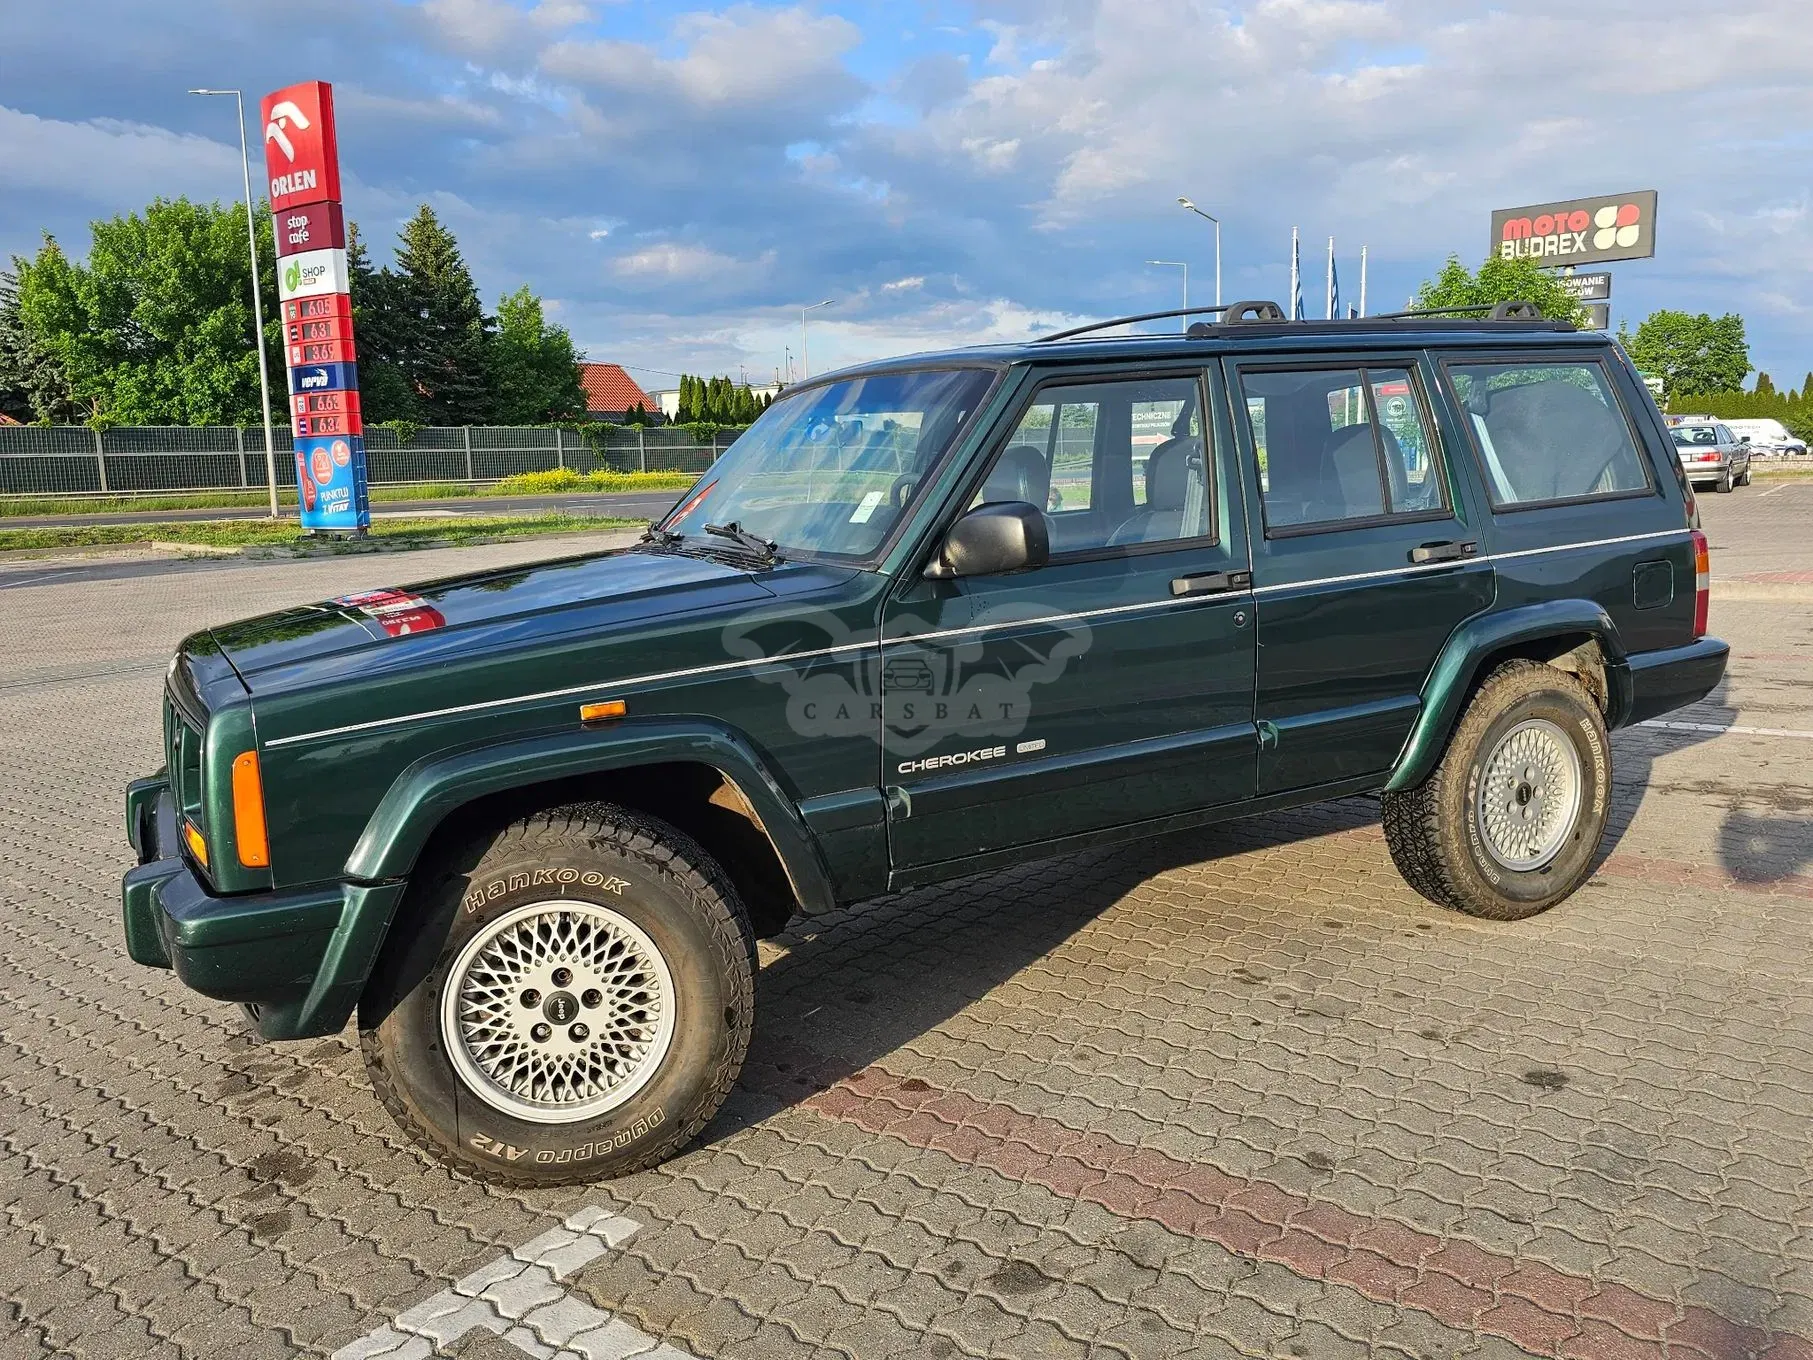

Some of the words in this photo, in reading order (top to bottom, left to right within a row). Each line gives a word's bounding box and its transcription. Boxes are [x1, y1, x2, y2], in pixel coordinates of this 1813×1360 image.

[271, 169, 317, 198] ORLEN
[287, 215, 308, 230] stop
[1502, 210, 1590, 240] MOTO
[1501, 230, 1588, 261] BUDREX
[302, 266, 325, 278] SHOP
[301, 374, 329, 388] verva
[1131, 411, 1172, 421] ECHNICZNE
[897, 745, 1006, 774] CHEROKEE
[557, 998, 566, 1020] Jeep
[469, 1131, 530, 1162] AT2
